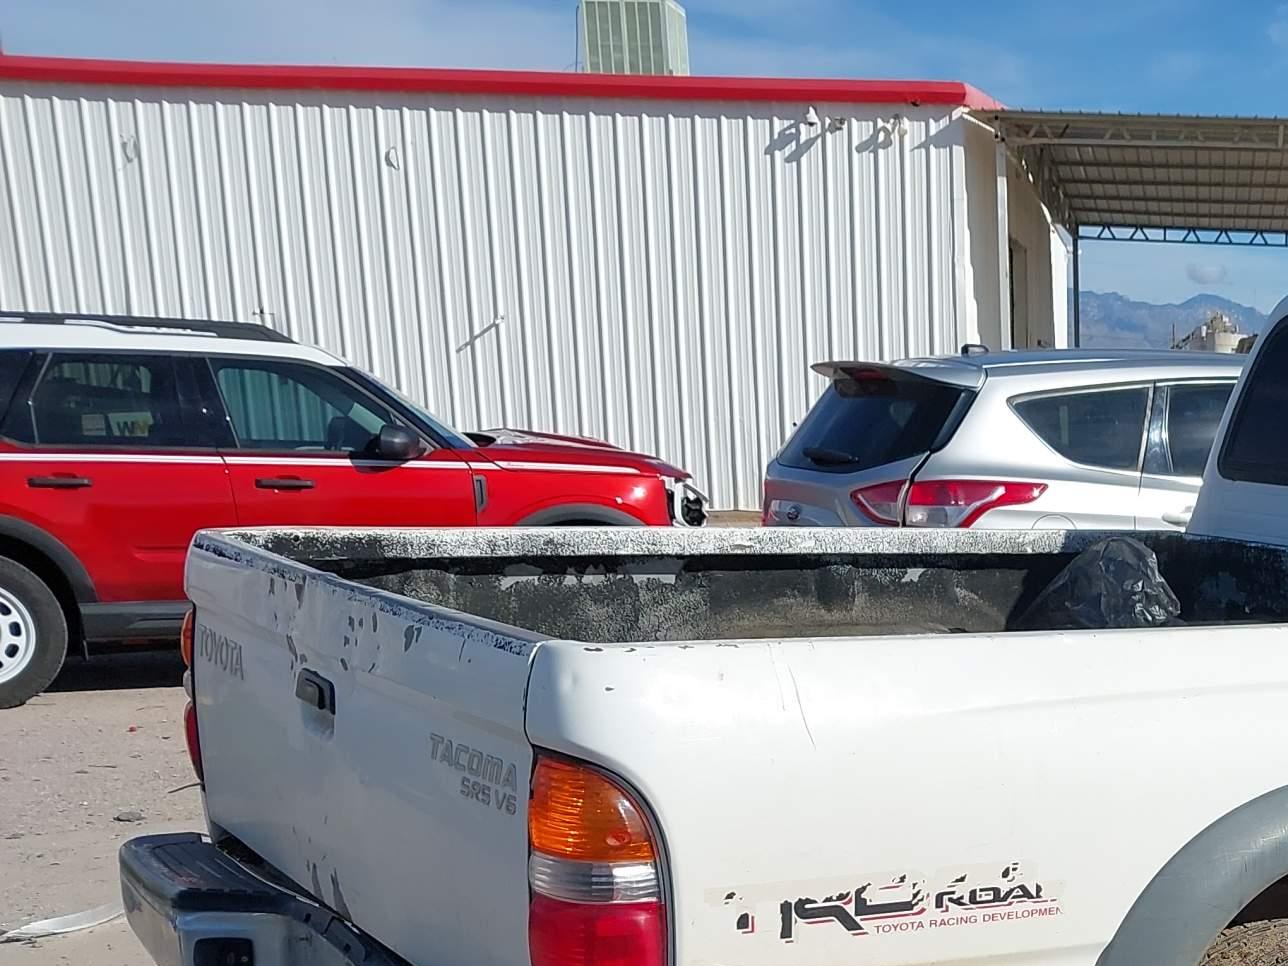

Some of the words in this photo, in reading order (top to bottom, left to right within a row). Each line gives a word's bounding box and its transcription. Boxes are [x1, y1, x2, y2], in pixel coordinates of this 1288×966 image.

[199, 623, 244, 681] TOYOTA
[430, 732, 517, 793] TACOMA
[460, 776, 492, 807] SR5
[494, 788, 517, 816] V6
[874, 919, 925, 934] TOYOTA
[929, 914, 978, 929] RACING
[982, 906, 1064, 923] DEVELOPMEN
